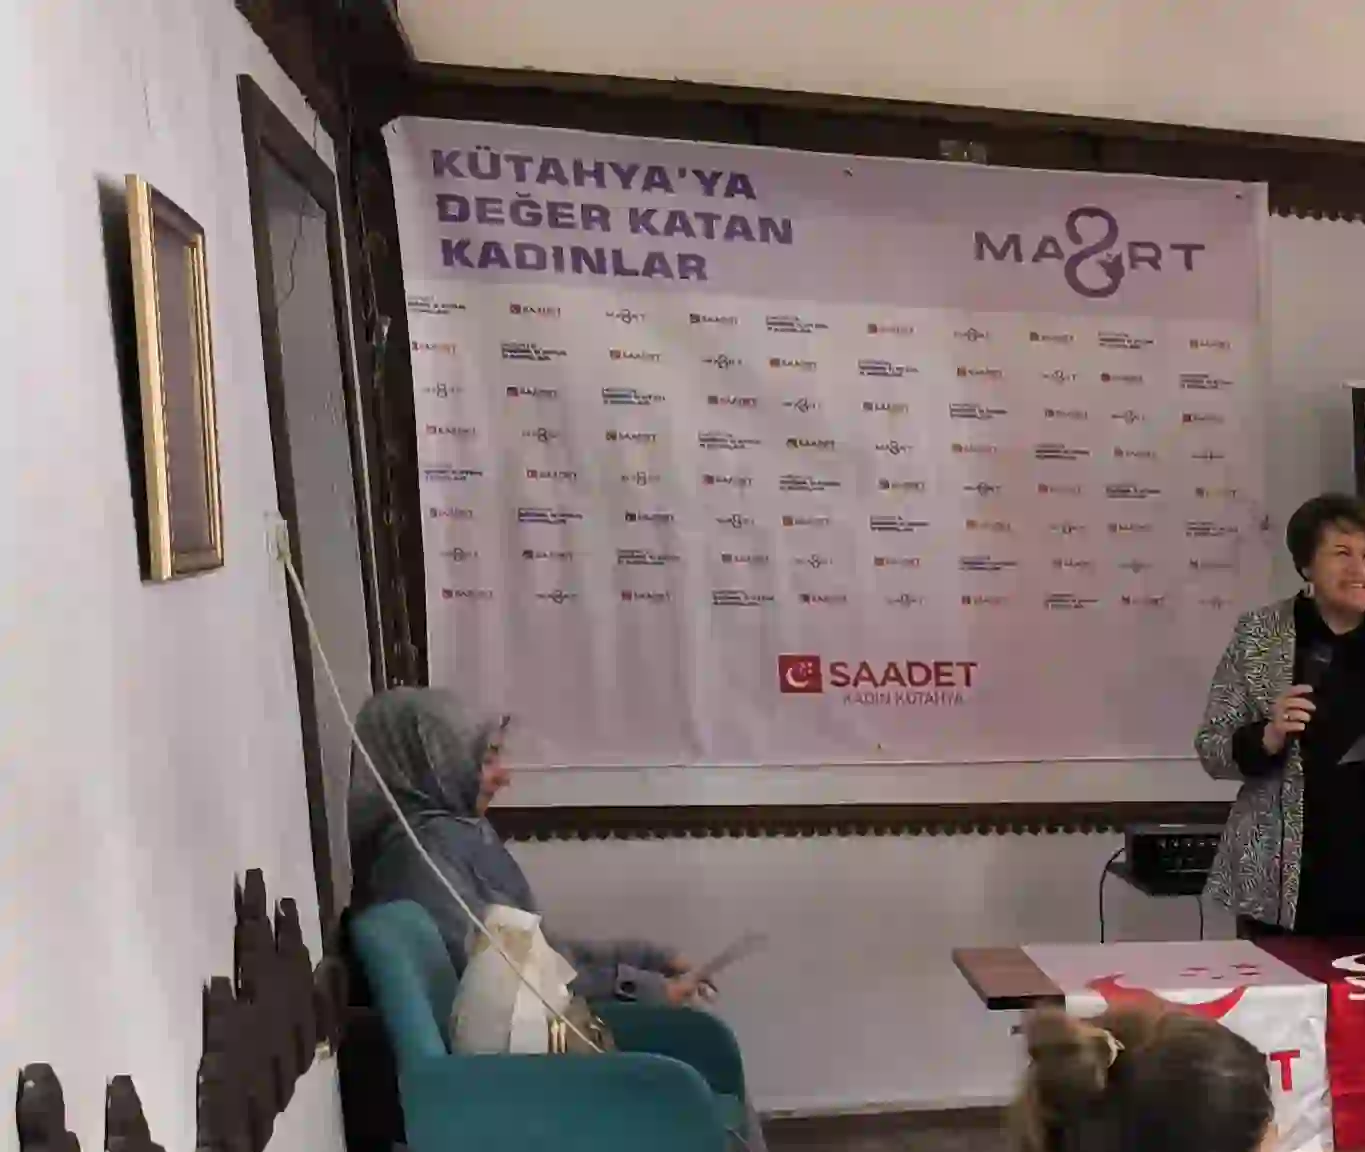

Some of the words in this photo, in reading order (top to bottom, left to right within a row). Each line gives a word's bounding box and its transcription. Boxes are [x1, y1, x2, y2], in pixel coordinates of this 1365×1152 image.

[431, 145, 757, 200] KÜTAHYA'YA
[435, 192, 611, 233] DEĞER
[629, 207, 793, 244] KATAN
[439, 238, 708, 281] KADINLAR
[829, 660, 978, 688] SAADET
